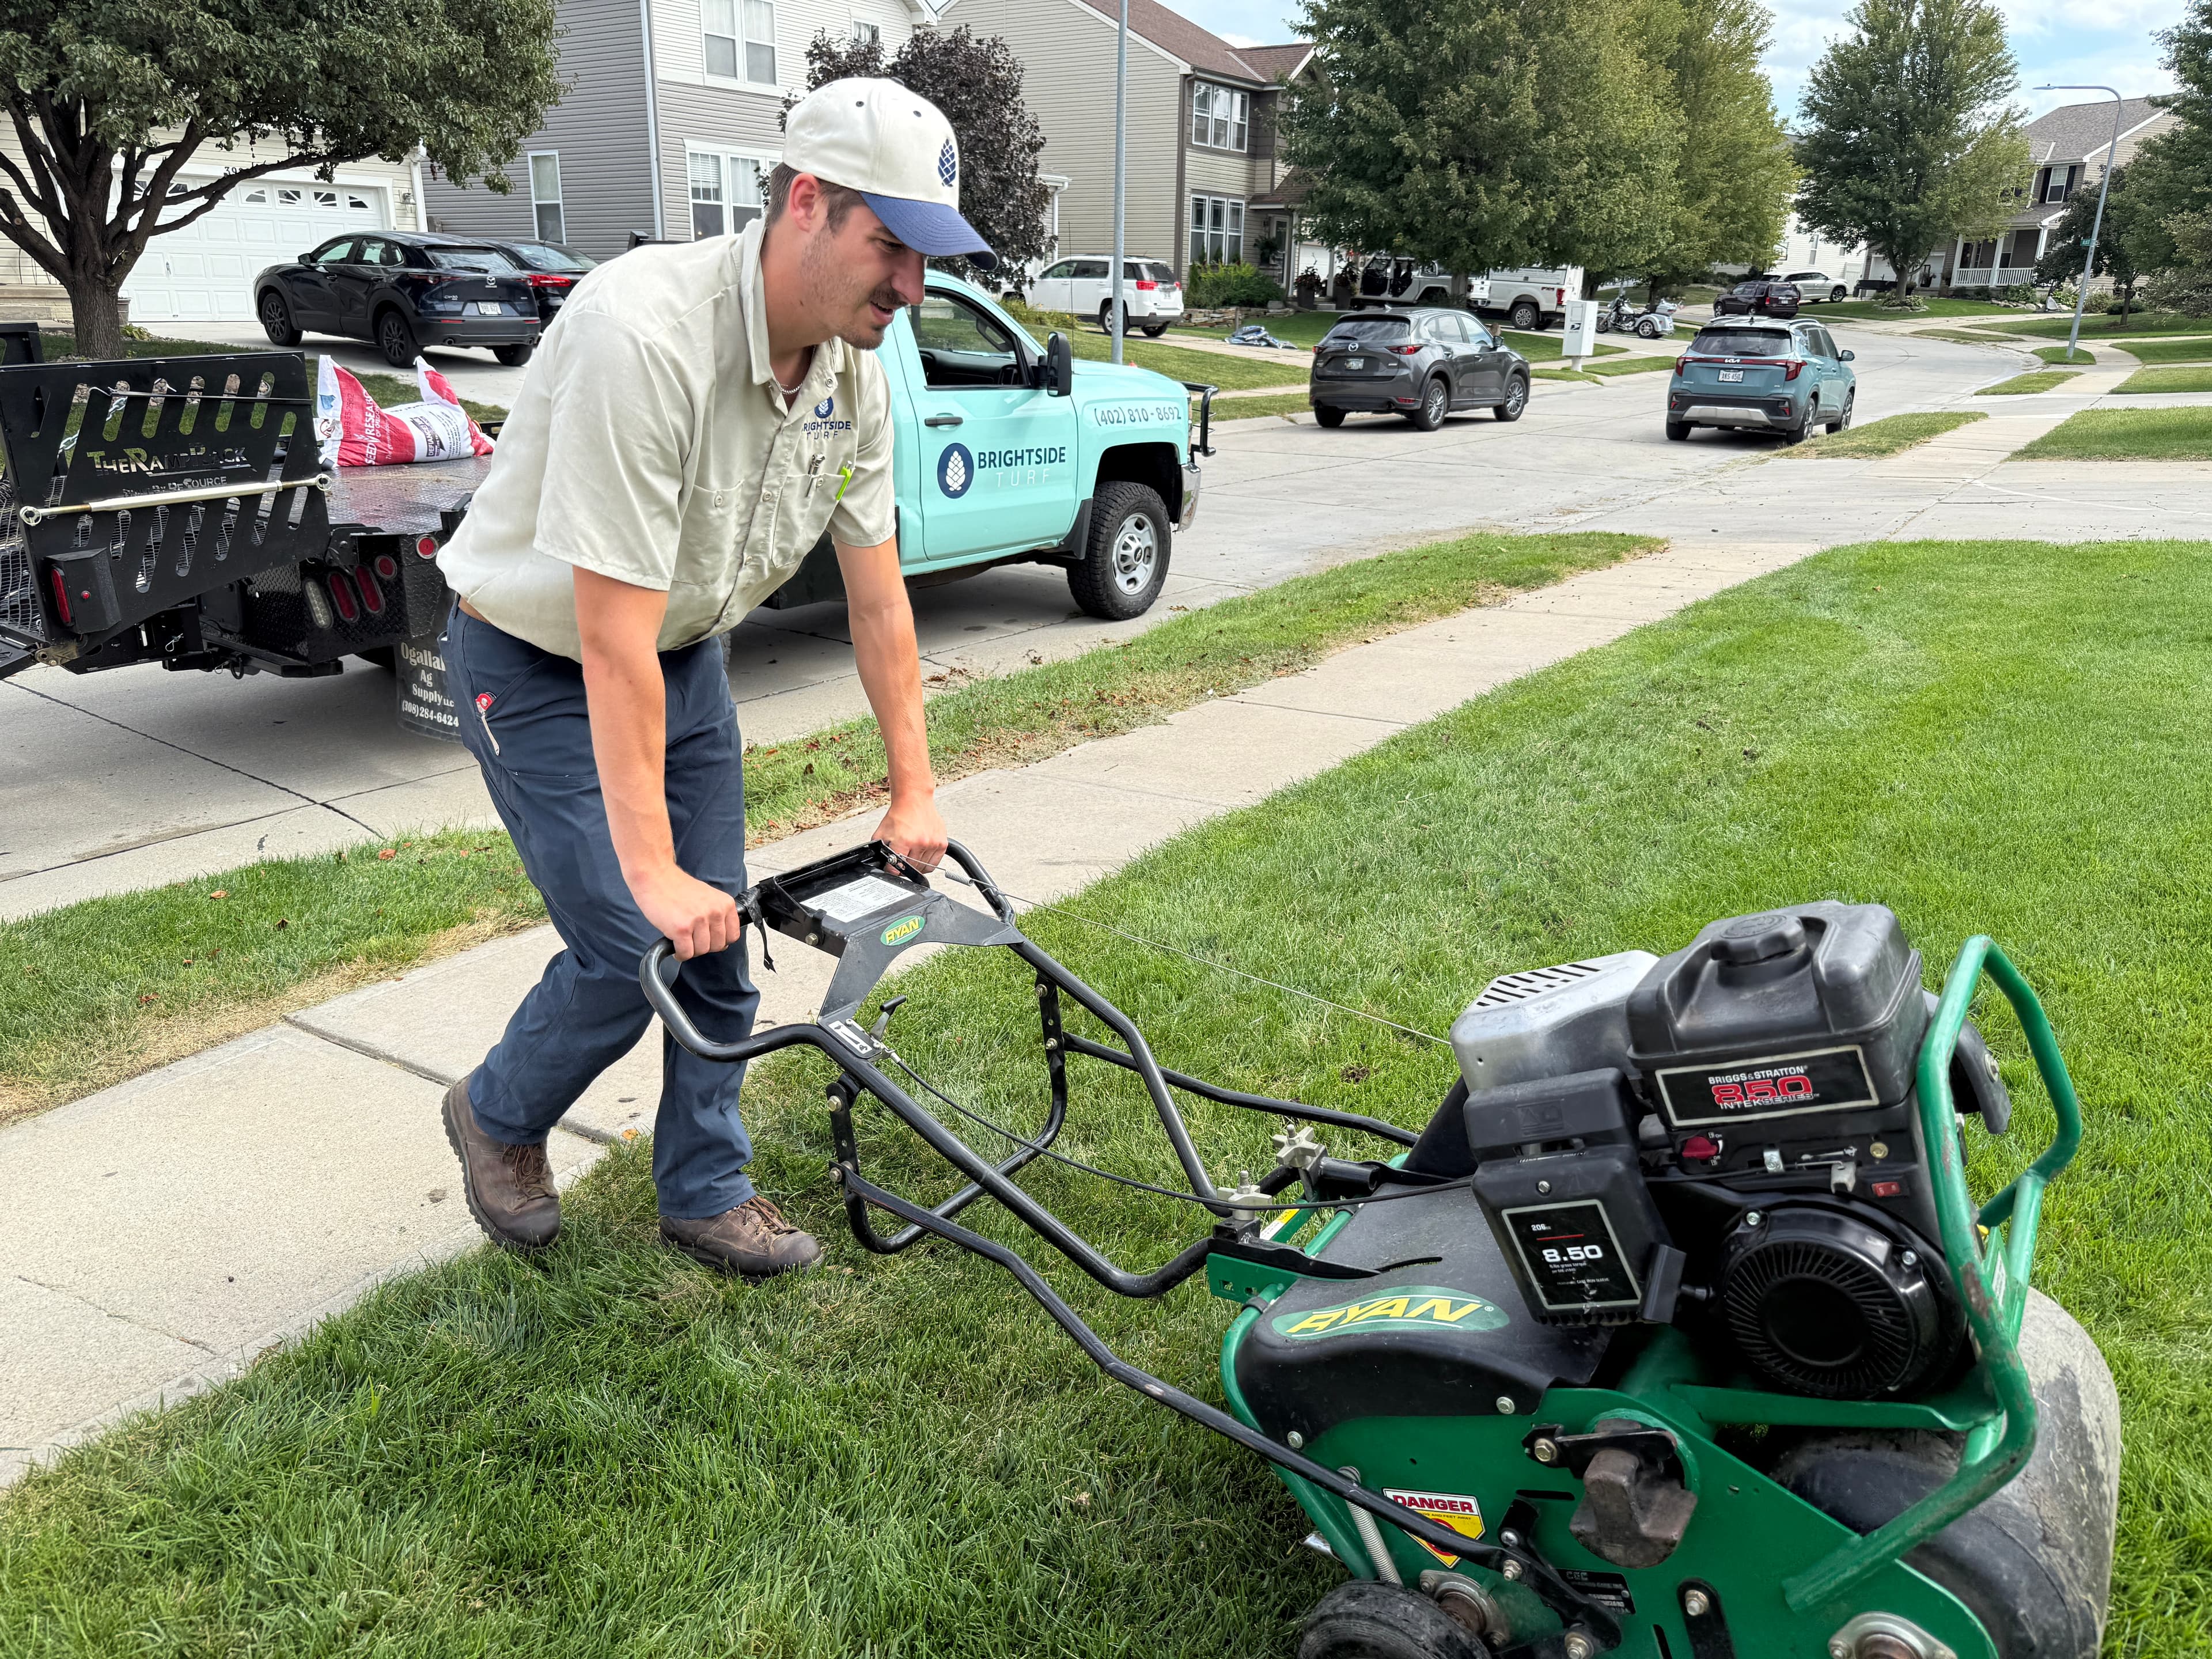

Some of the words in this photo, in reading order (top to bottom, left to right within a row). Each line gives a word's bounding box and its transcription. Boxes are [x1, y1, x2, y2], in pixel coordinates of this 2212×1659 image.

[363, 388, 376, 435] RESEARC
[1094, 407, 1126, 426] (402)
[802, 421, 851, 431] RIGHTSIDE
[806, 431, 838, 440] TURF
[365, 442, 377, 465] SEED
[978, 446, 1066, 469] BRIGHTSIDE
[996, 468, 1050, 488] TURF
[401, 642, 446, 671] Ogallal
[421, 669, 433, 687] Ag
[412, 683, 442, 706] Supply
[443, 698, 454, 707] LLC
[885, 917, 921, 945] RYAN
[1711, 1075, 1813, 1105] 850
[1542, 1245, 1603, 1263] 8.50
[1286, 1298, 1483, 1333] RYAN
[1392, 1495, 1475, 1513] DANGER
